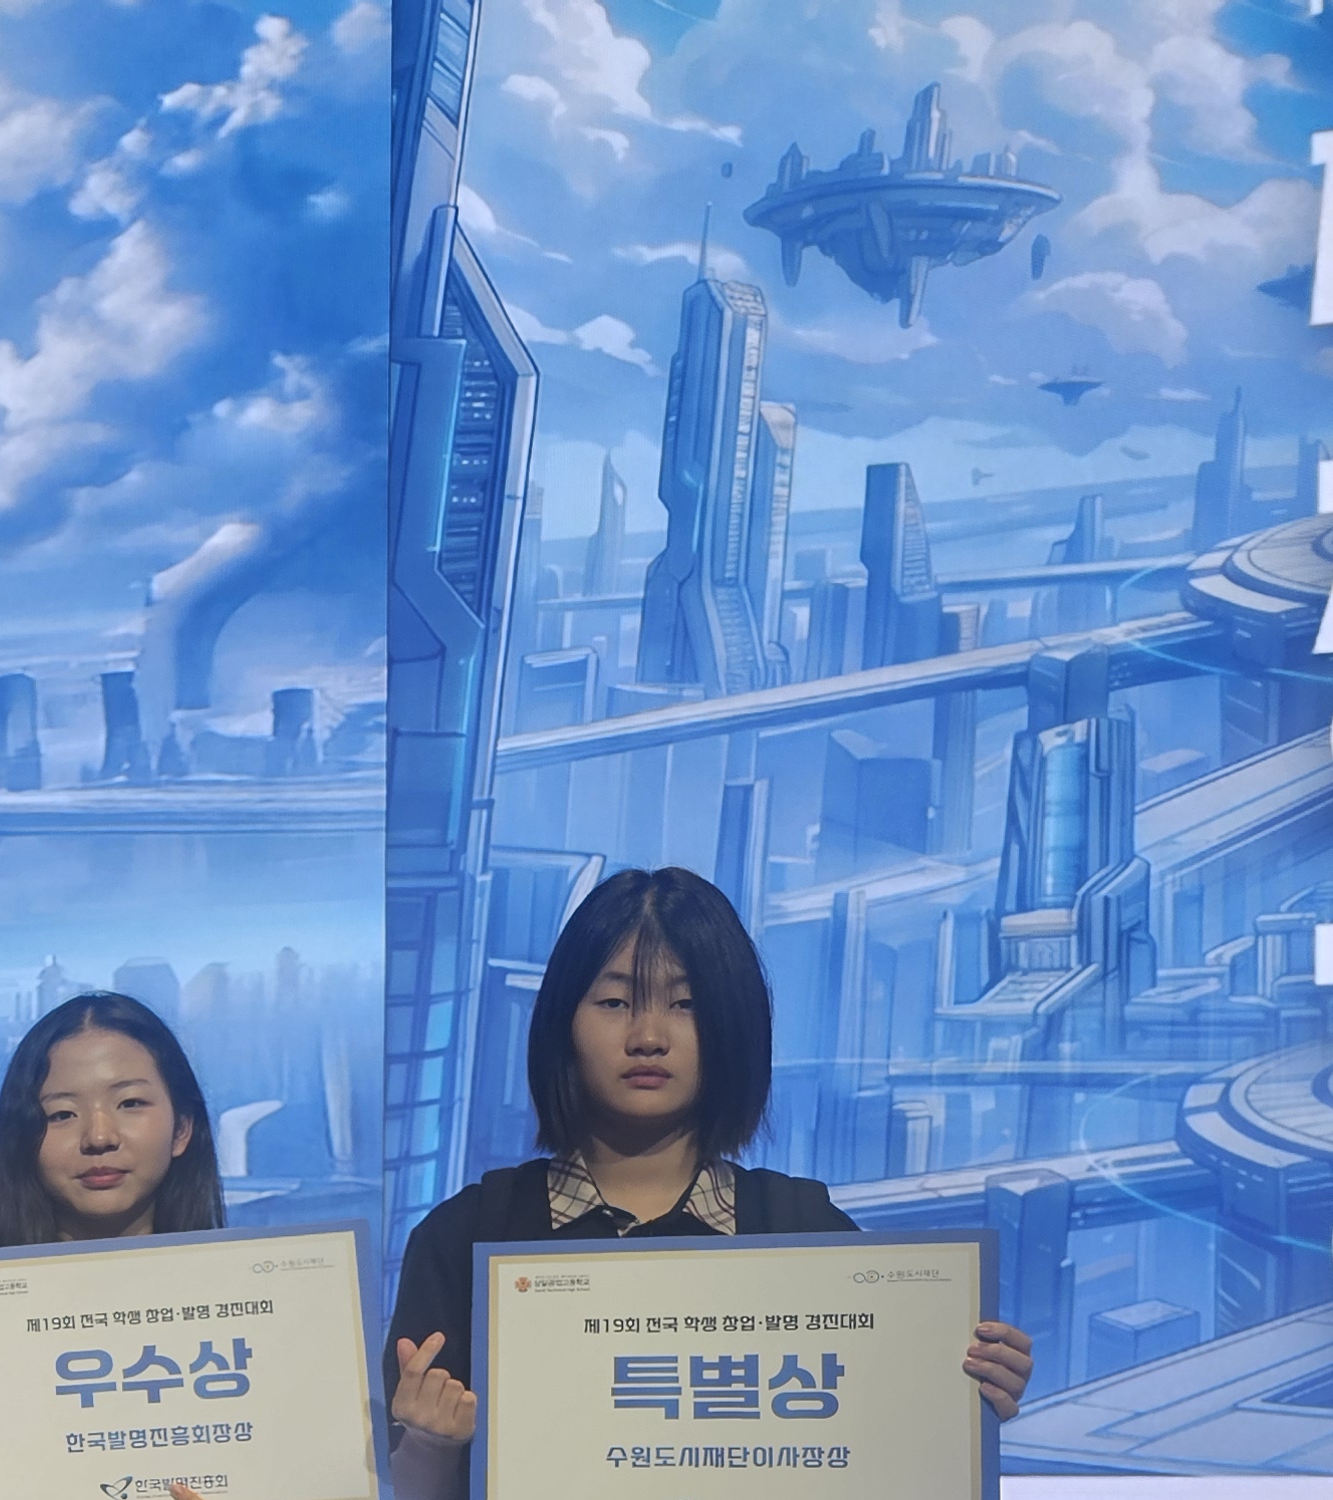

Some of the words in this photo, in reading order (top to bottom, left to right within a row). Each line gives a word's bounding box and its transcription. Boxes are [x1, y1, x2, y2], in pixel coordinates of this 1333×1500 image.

[80, 1313, 108, 1328] 전국
[113, 1310, 141, 1325] 학생
[215, 1299, 273, 1319] 경진대회
[646, 1315, 679, 1333] 전국
[684, 1314, 717, 1332] 학생
[805, 1312, 874, 1331] 경진대회
[55, 1337, 252, 1408] 우수상
[611, 1352, 845, 1421] 특별상
[66, 1421, 253, 1453] 한국발명진흥회장상
[606, 1445, 851, 1469] 수원도시재단이사장상
